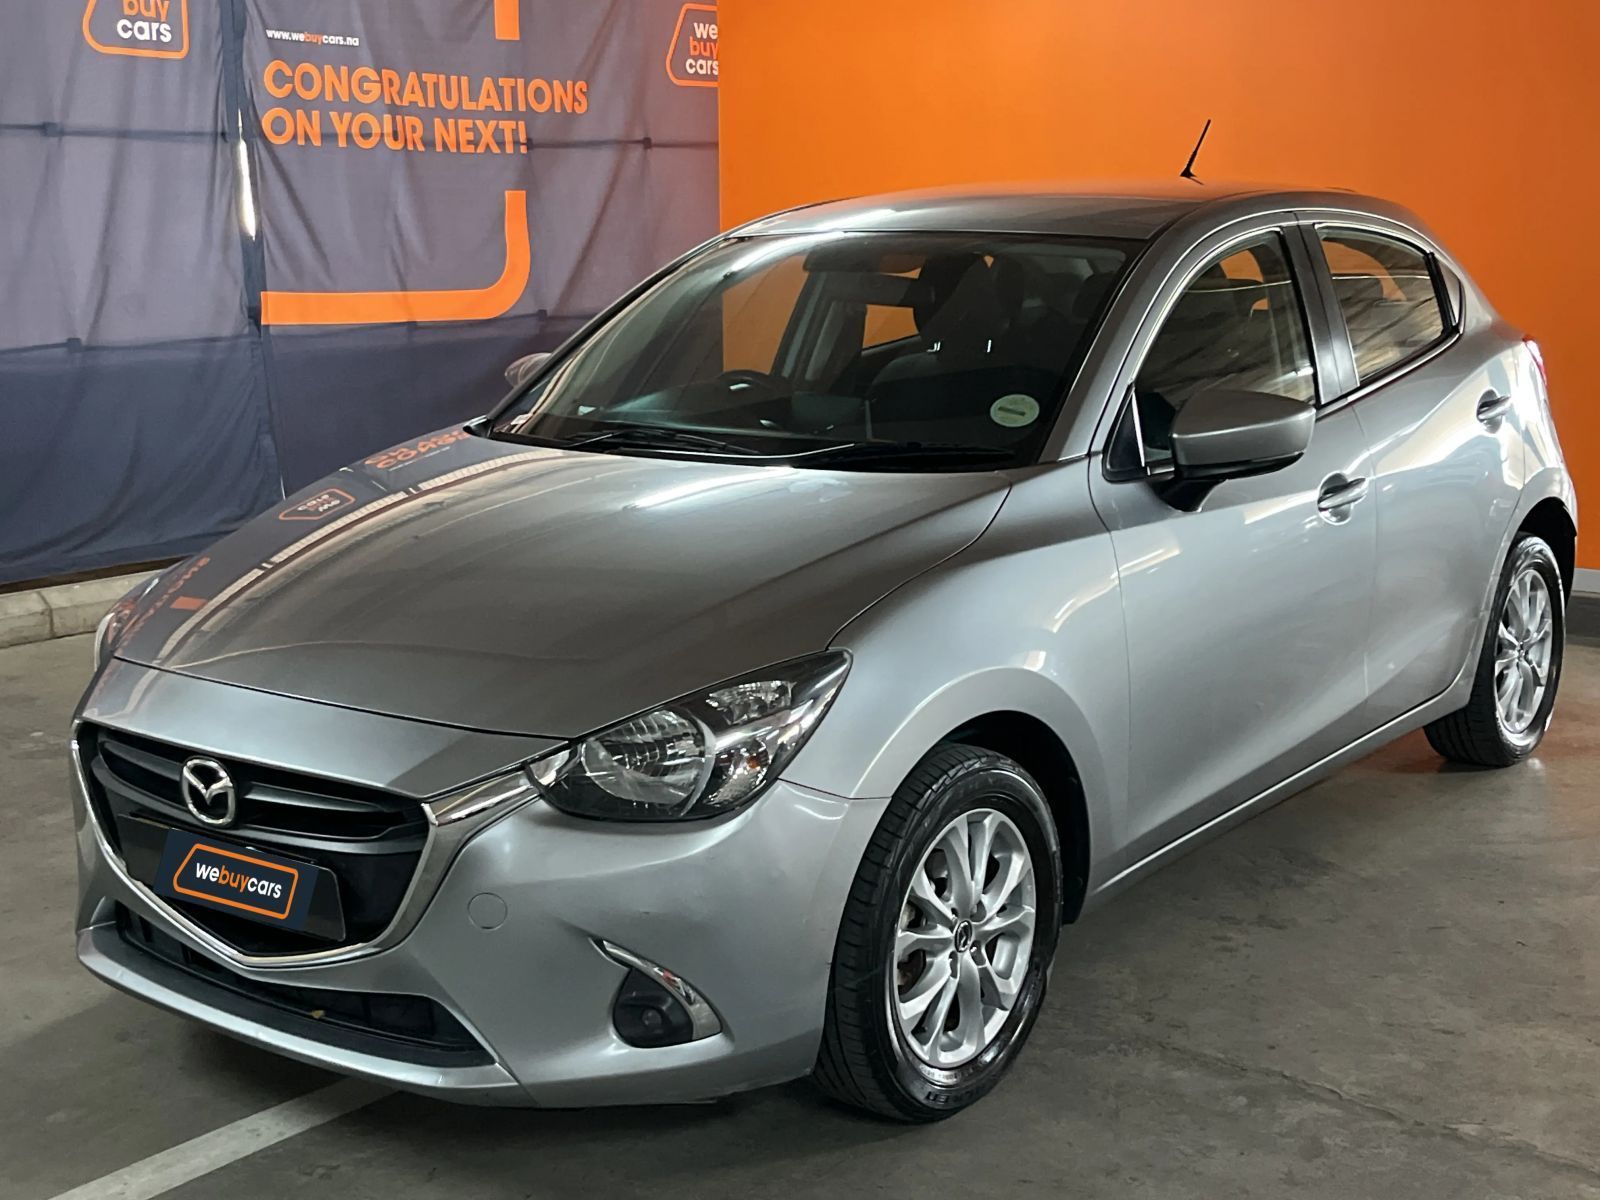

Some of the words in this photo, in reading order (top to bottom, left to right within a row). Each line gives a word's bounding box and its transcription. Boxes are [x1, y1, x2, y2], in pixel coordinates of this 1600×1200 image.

[117, 18, 172, 43] cars
[265, 29, 360, 47] www.webuycars.na
[693, 22, 718, 39] we
[689, 36, 718, 60] buy
[685, 58, 719, 76] cars
[263, 60, 589, 114] CONGRATULATIONS
[261, 107, 322, 147] ON
[329, 110, 425, 151] YOUR
[433, 117, 528, 154] NEXT!
